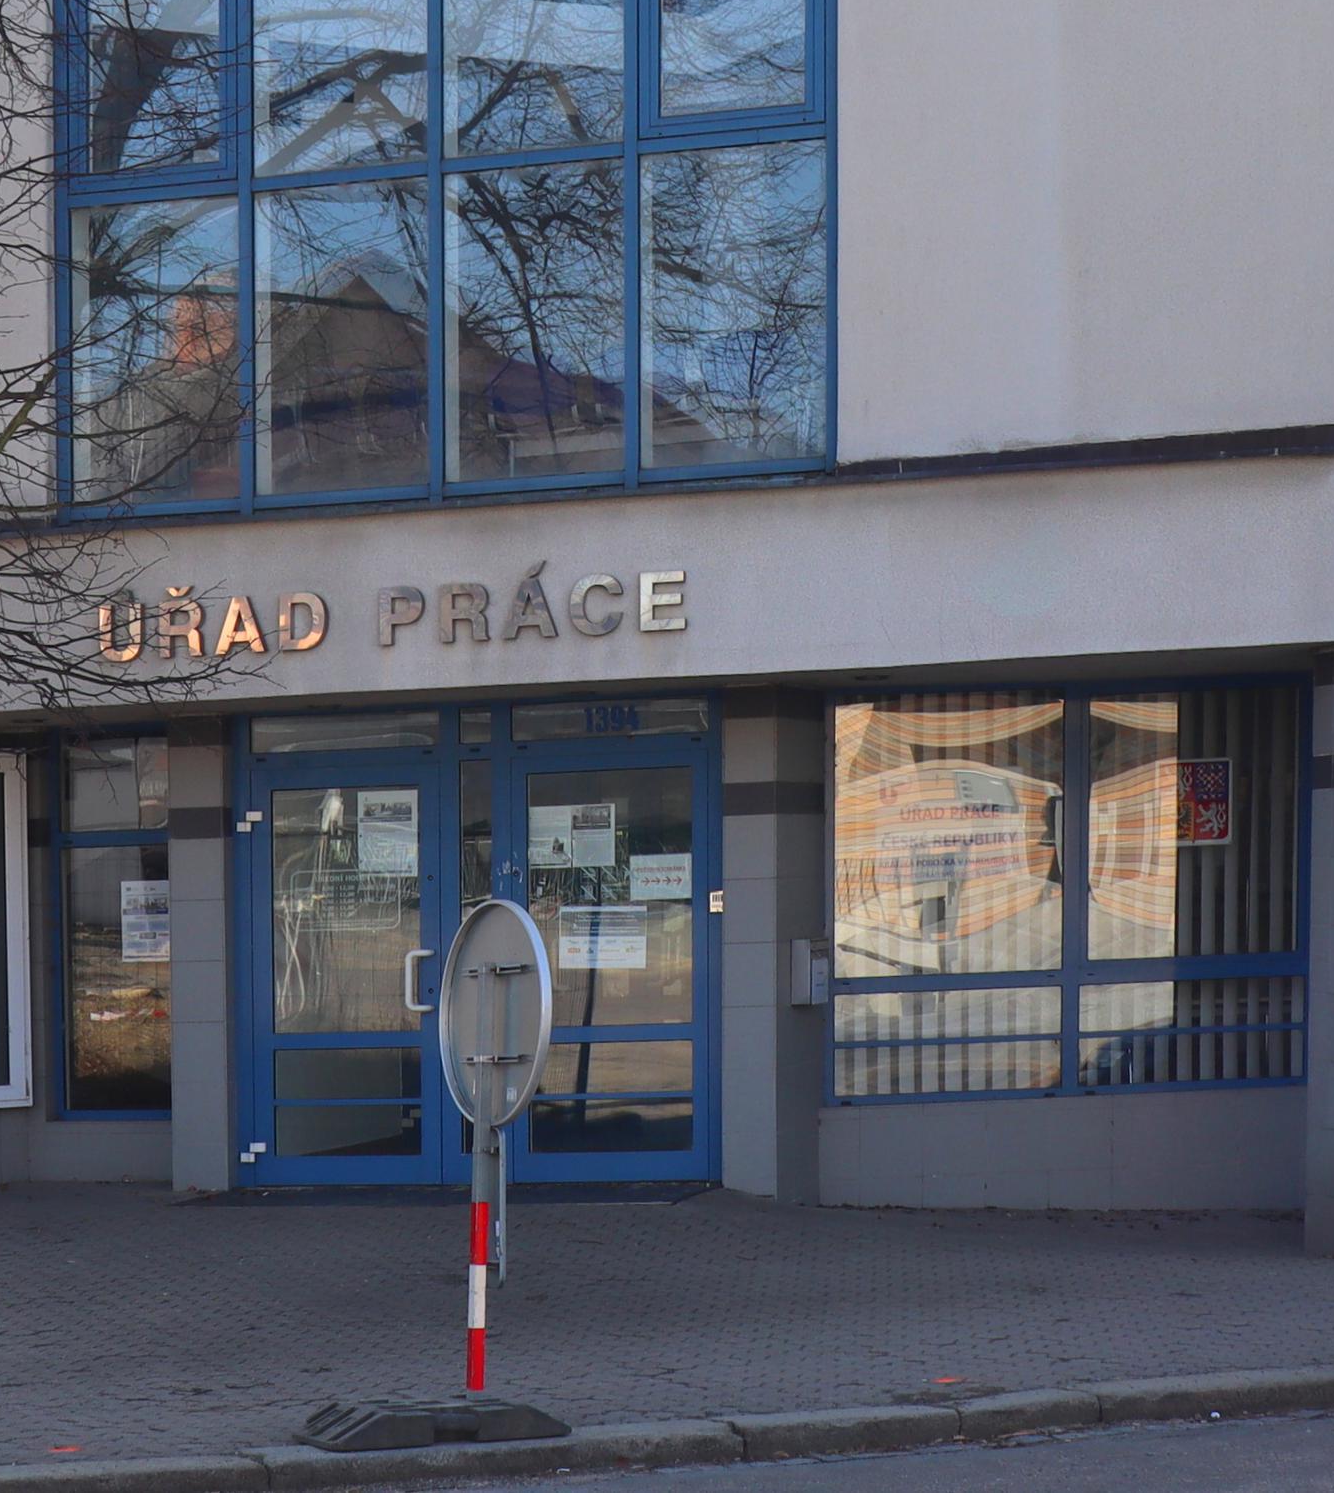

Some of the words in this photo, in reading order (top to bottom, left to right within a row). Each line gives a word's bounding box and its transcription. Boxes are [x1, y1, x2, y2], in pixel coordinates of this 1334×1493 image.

[97, 583, 329, 663] ÚŘAD
[378, 560, 687, 647] PRÁCE
[584, 705, 640, 733] 1394
[933, 831, 1017, 847] REPUBLIKY
